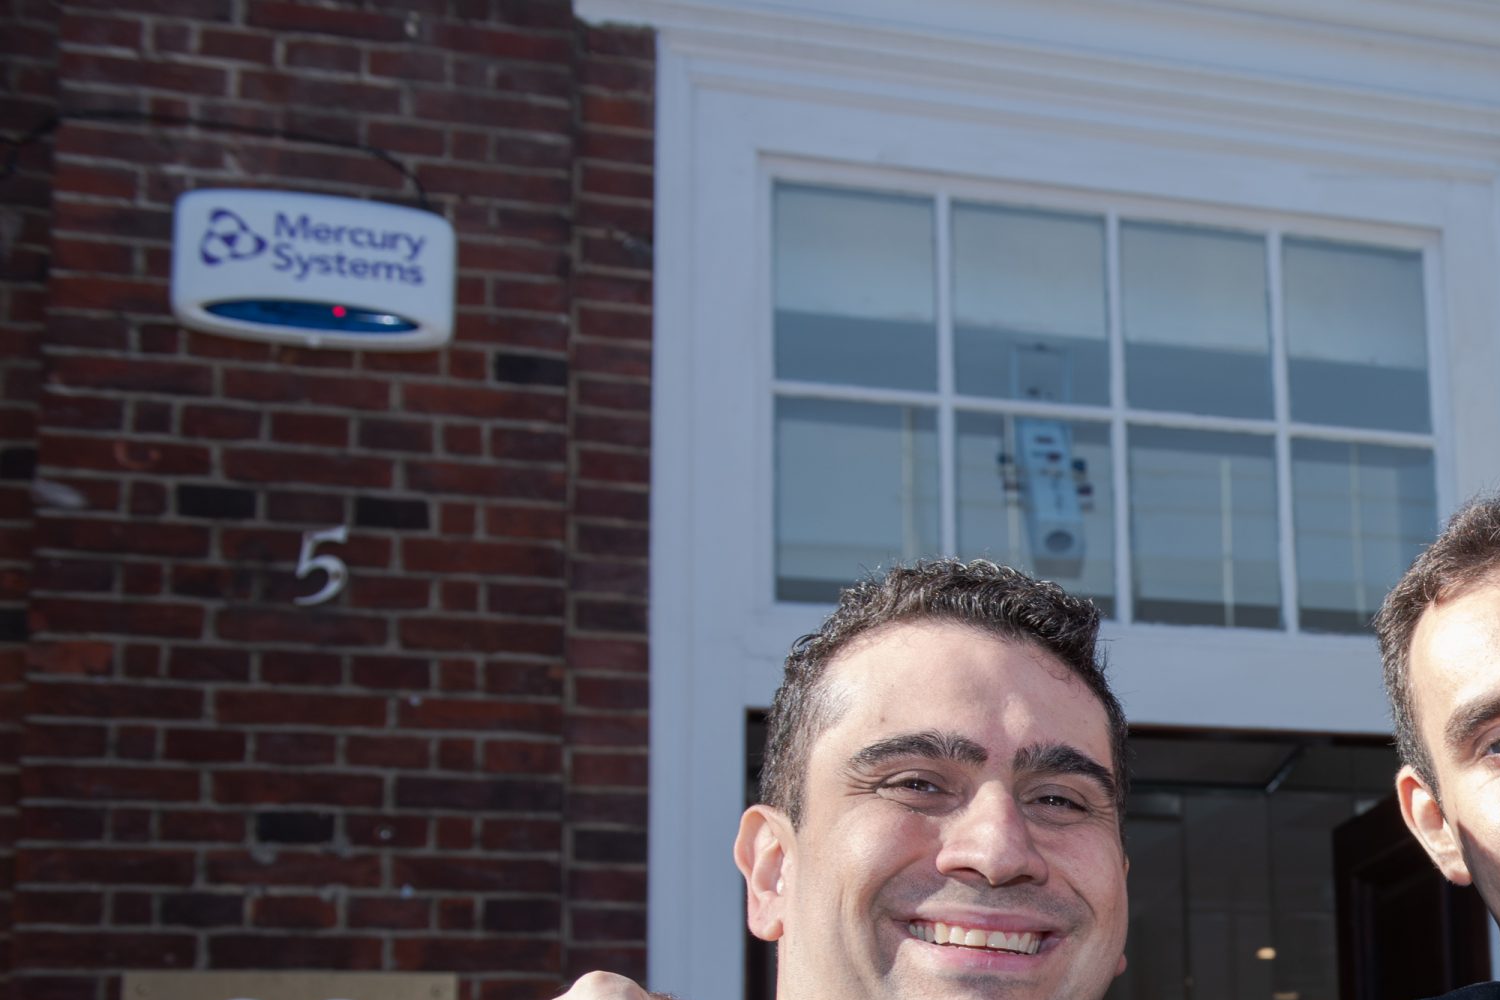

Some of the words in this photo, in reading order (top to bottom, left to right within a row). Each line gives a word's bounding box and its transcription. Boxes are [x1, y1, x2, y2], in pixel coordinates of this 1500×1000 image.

[273, 212, 426, 260] Mercury
[272, 243, 426, 286] Systems
[294, 525, 349, 606] 5
